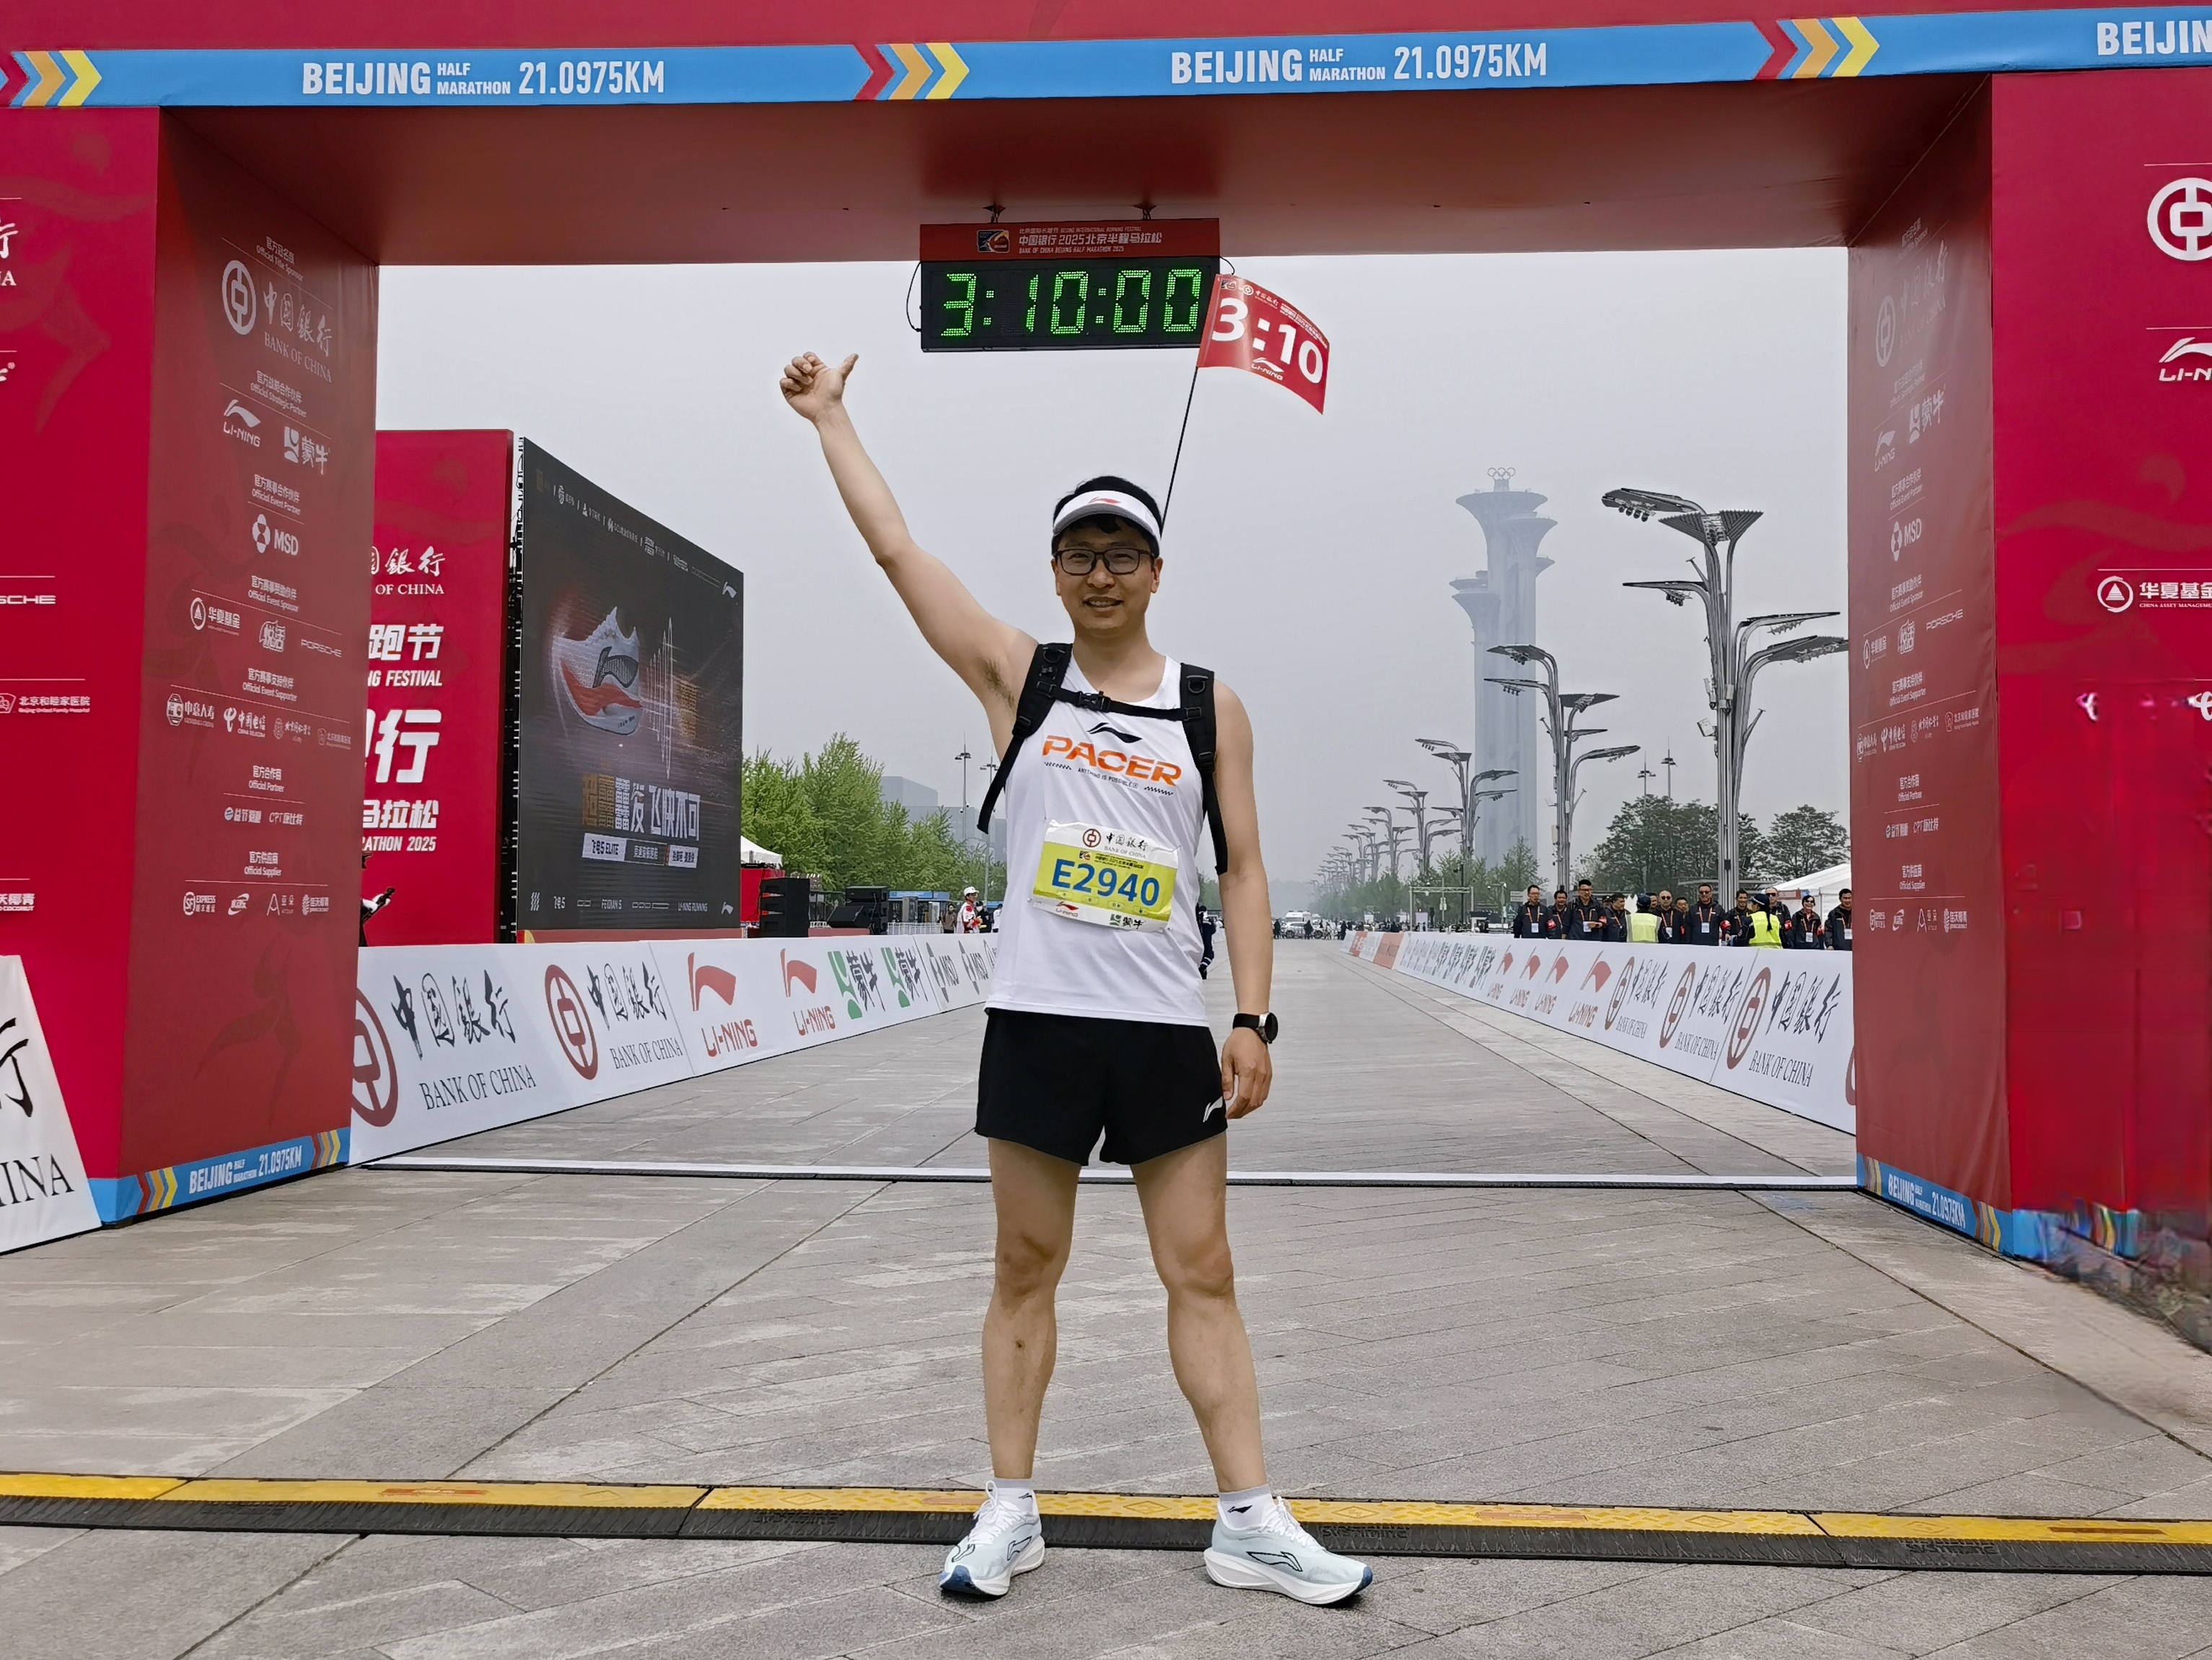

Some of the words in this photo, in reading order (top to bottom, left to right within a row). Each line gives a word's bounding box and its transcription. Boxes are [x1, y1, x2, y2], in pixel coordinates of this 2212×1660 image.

[436, 63, 470, 76] HALF
[1171, 48, 1303, 84] BEIJING
[1309, 48, 1344, 63] HALF
[1393, 42, 1547, 80] 21.0975KM
[302, 61, 431, 95] BEIJING
[436, 81, 511, 95] MARATHON
[518, 60, 664, 95] 21.0975KM
[1309, 66, 1386, 82] MARATHON
[940, 268, 1203, 337] 3:10:00
[1211, 297, 1323, 384] 3:10
[264, 332, 289, 359] BANK
[291, 348, 302, 366] OF
[304, 356, 332, 383] CHINA
[1251, 364, 1283, 381] LI-NING
[223, 421, 262, 447] LI-NING
[302, 435, 328, 475] 蒙牛
[273, 529, 299, 556] MSD
[1904, 518, 1923, 547] MSD
[375, 584, 395, 595] OF
[398, 584, 444, 595] CHINA
[1926, 609, 1964, 631] PORSCHE
[300, 638, 343, 658] PORSCHE
[385, 669, 443, 687] FESTIVAL
[1042, 734, 1182, 787] PACER
[406, 836, 437, 852] 2025
[1104, 846, 1120, 854] BANK
[1128, 850, 1146, 859] CHINA
[1052, 858, 1160, 907] E2940
[1123, 916, 1144, 929] 蒙牛
[793, 1005, 836, 1036] LI-NING
[1568, 1001, 1599, 1028] LI-NING
[610, 1045, 641, 1070] BANK
[639, 1041, 653, 1064] OF
[651, 1037, 683, 1060] CHINA
[701, 1019, 758, 1058] LI-NING
[1675, 1032, 1693, 1053] BANK
[1690, 1035, 1703, 1055] OF
[1698, 1037, 1720, 1060] CHINA
[1749, 1050, 1773, 1075] BANK
[1770, 1057, 1785, 1079] OF
[1783, 1059, 1814, 1087] CHINA
[418, 1076, 469, 1110] BANK
[468, 1073, 488, 1100] OF
[489, 1064, 537, 1095] CHINA
[189, 1161, 233, 1195] BEIJING
[258, 1145, 302, 1178] 21.0975KM
[1888, 1173, 1915, 1207] BEIJING
[1931, 1190, 1966, 1229] 21.0975KM
